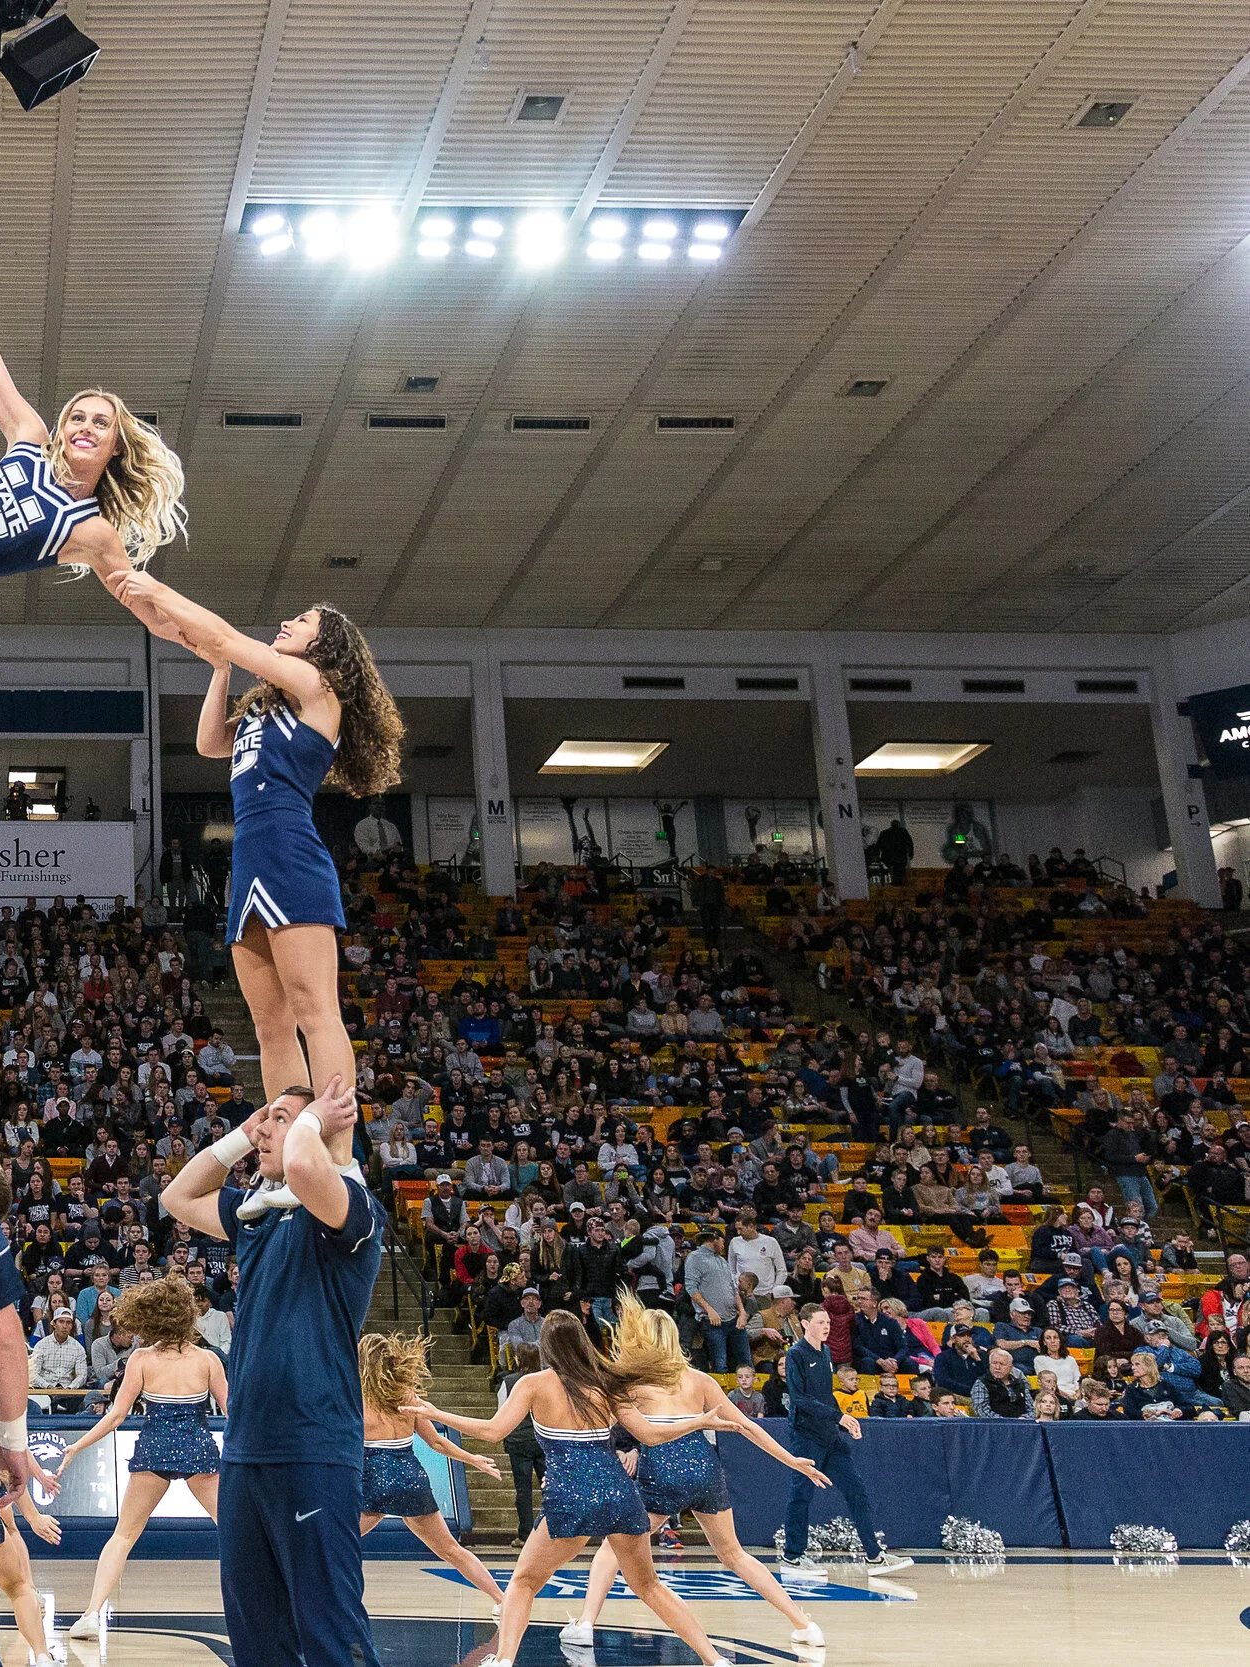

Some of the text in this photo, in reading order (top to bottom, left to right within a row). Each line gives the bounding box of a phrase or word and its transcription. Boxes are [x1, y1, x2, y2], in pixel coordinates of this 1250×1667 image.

[1220, 726, 1250, 743] AM
[233, 730, 263, 758] TATE
[488, 799, 504, 815] M
[838, 803, 853, 819] N
[1187, 805, 1200, 820] P
[0, 870, 72, 885] Furnishings
[90, 902, 114, 911] Outle
[27, 1432, 67, 1448] EVADA
[97, 1447, 105, 1458] F
[97, 1461, 106, 1477] 2
[97, 1496, 108, 1512] 4
